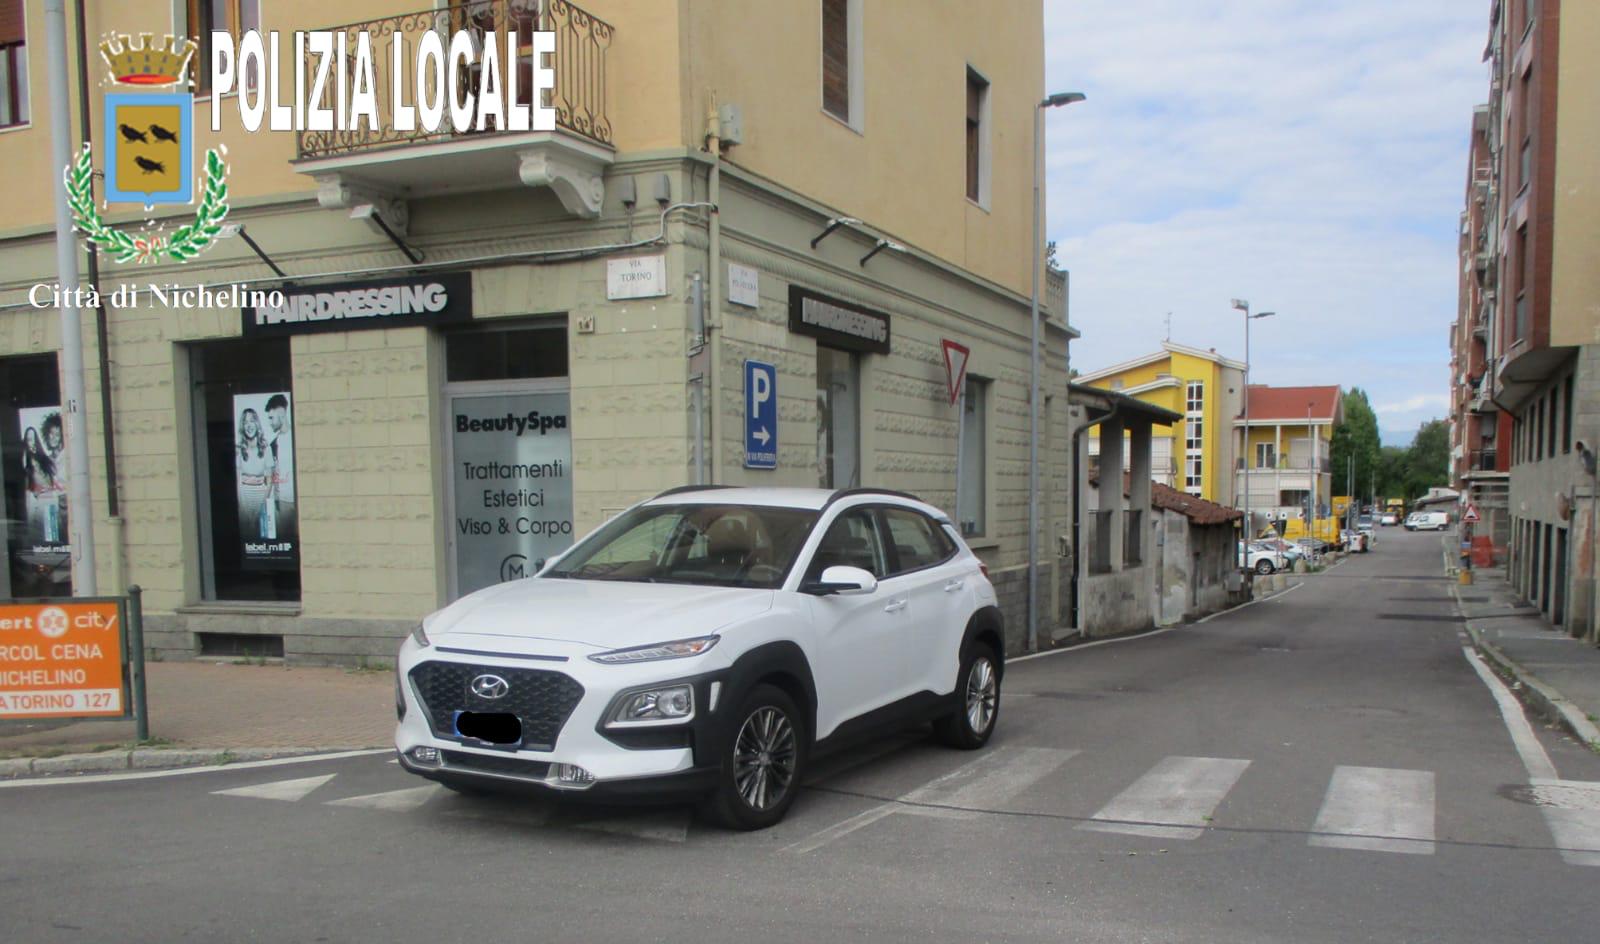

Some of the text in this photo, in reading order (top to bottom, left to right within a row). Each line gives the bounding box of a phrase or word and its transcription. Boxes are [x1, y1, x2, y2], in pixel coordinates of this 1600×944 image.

[629, 260, 641, 268] VIA
[621, 271, 652, 282] TORINO
[255, 283, 448, 325] HAIRDRESSING
[753, 367, 770, 419] P
[456, 410, 567, 436] BeautySpa
[463, 459, 563, 480] Trattamenti
[483, 489, 544, 508] Estetici
[458, 517, 572, 538] Viso & Corpo
[74, 611, 118, 631] city
[51, 643, 103, 660] CENA
[10, 694, 74, 709] TORINO
[83, 692, 111, 708] 127
